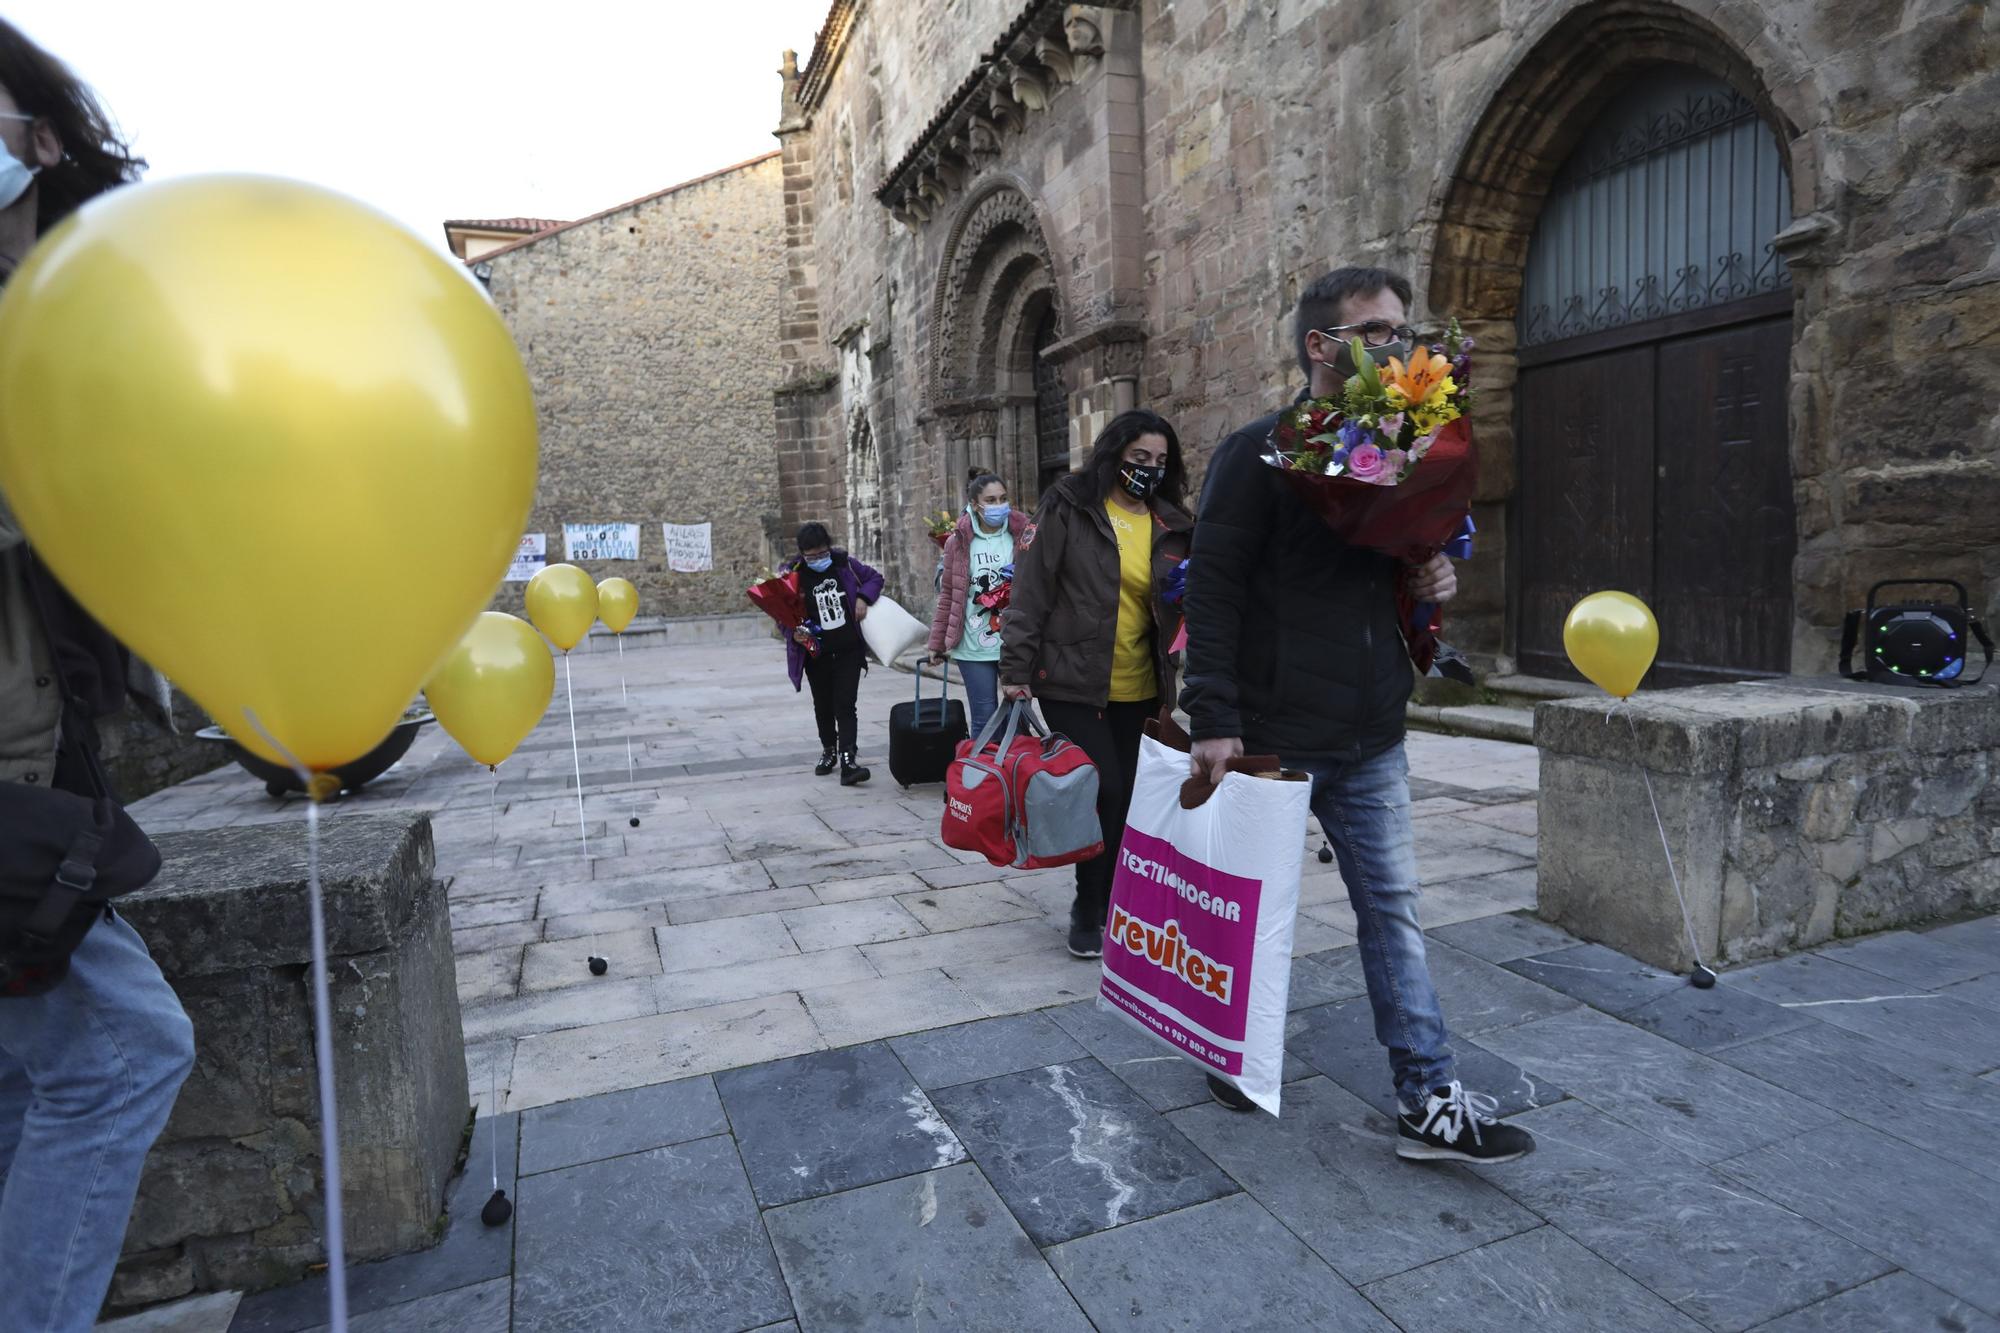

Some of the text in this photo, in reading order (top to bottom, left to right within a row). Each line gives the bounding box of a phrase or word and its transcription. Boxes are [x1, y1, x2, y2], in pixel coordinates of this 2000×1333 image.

[975, 552, 1000, 565] The
[1176, 876, 1241, 923] HOGAR
[1110, 907, 1231, 1004] revitex
[1102, 983, 1228, 1066] www.revitex.com 987 802 608
